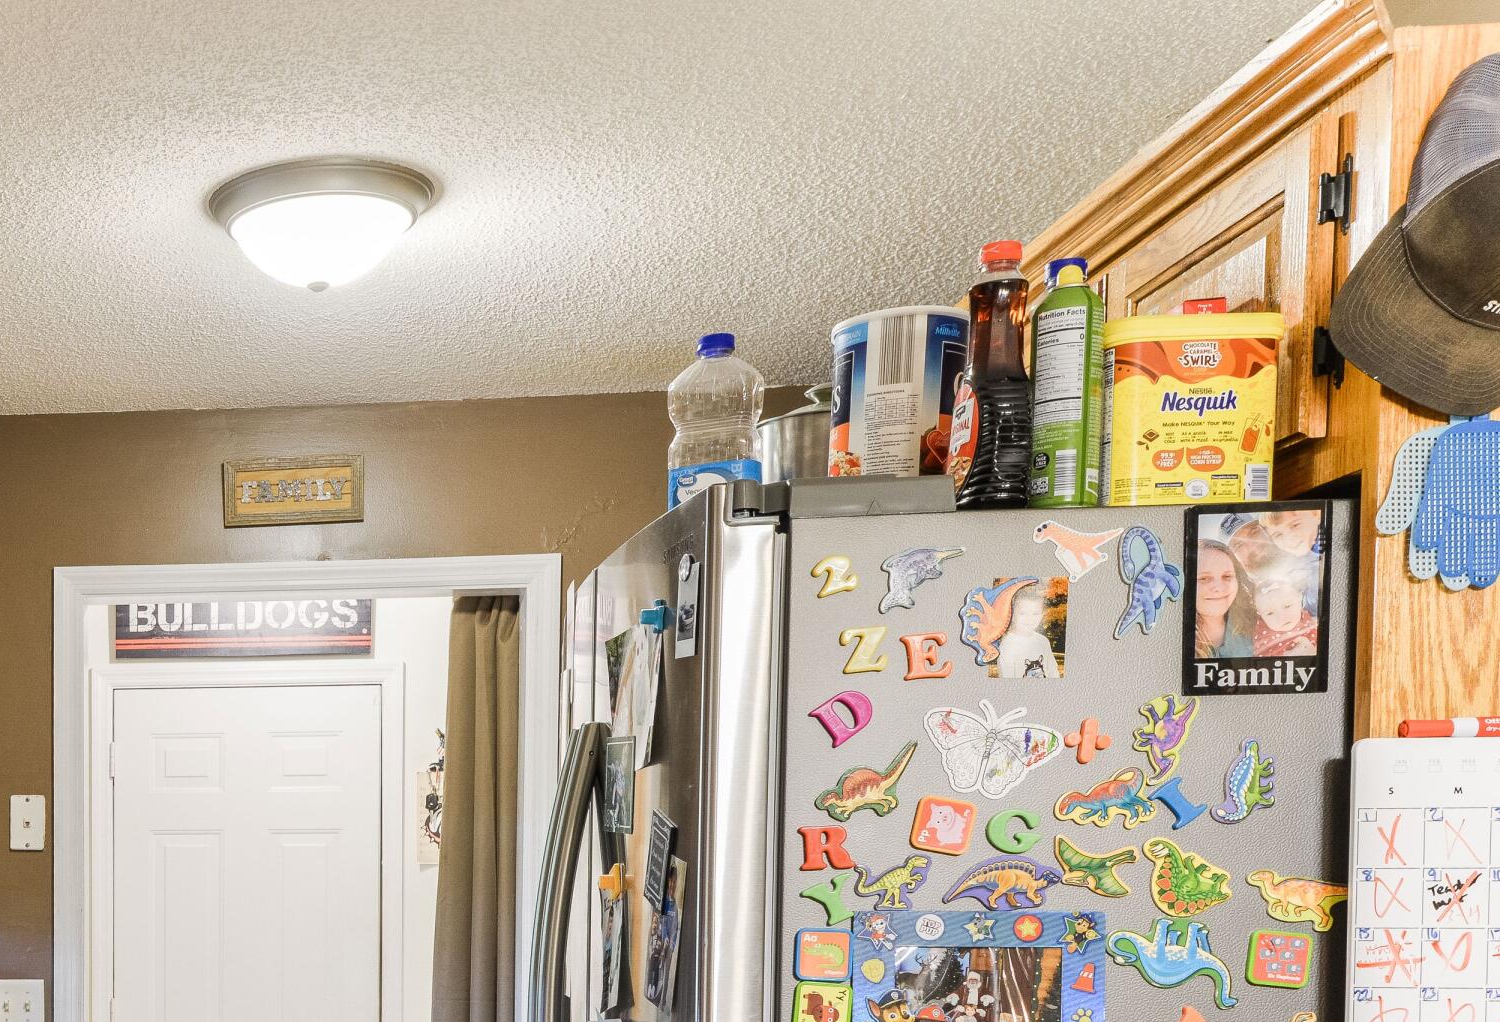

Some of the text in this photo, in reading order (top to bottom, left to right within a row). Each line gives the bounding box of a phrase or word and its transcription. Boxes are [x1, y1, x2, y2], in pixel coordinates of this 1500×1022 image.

[1039, 308, 1086, 321] Nutrition Facts
[1079, 332, 1085, 341] 0
[1183, 354, 1218, 367] SWIRL
[1161, 390, 1238, 417] Nesquik
[241, 477, 349, 503] FAMILY
[128, 599, 358, 633] BULLDOGS
[840, 626, 889, 674] Z
[900, 632, 953, 681] E
[1193, 661, 1316, 691] Family
[809, 691, 872, 748] D
[986, 809, 1042, 853] G
[798, 825, 856, 871] R
[1362, 870, 1373, 881] 8
[1429, 869, 1437, 880] 9
[802, 873, 854, 926] Y
[920, 926, 940, 936] PUP
[923, 918, 942, 928] TOP
